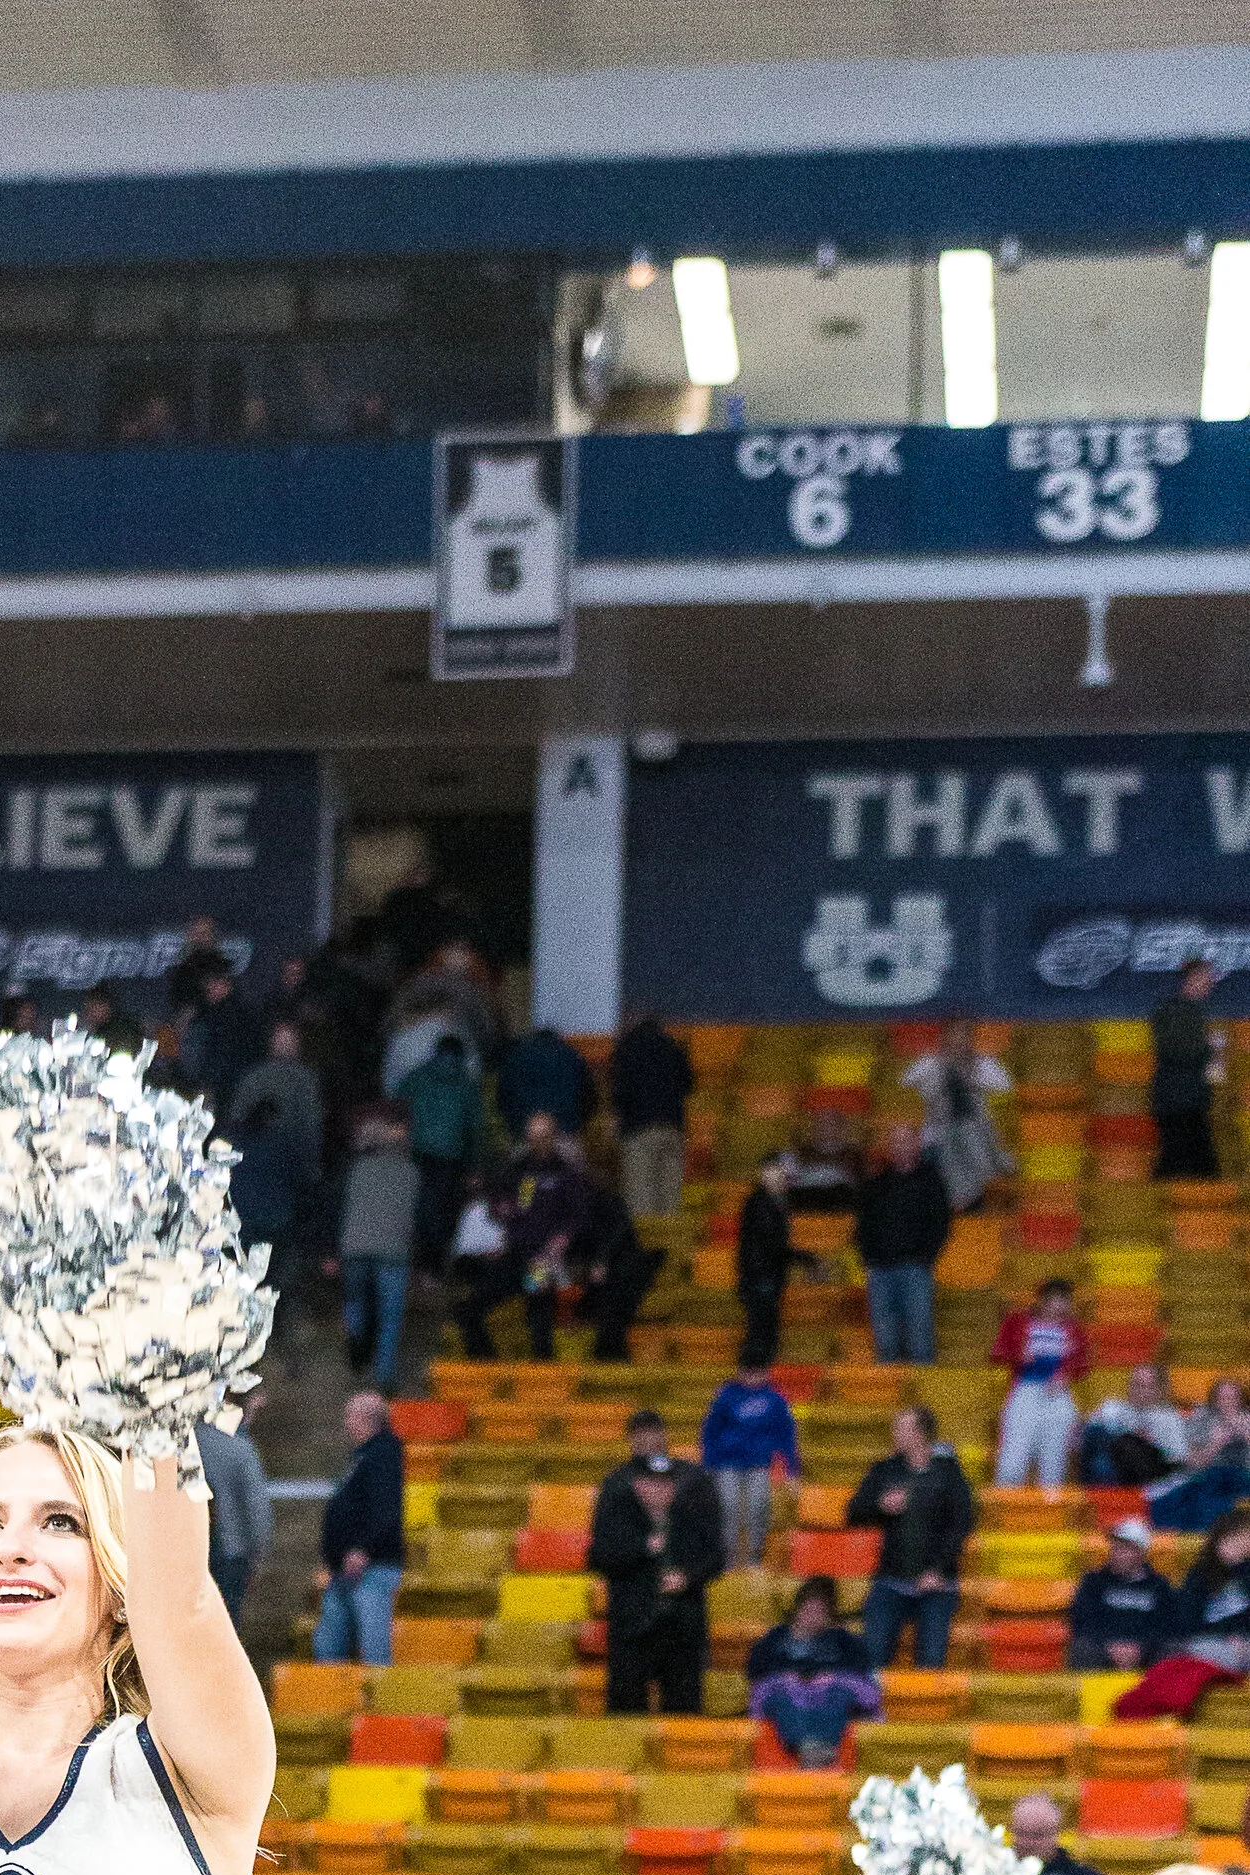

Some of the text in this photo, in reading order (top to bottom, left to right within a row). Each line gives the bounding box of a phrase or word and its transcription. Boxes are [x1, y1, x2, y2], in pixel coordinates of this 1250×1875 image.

[737, 431, 903, 479] COOK
[1007, 423, 1191, 472] ESTES
[789, 477, 851, 548] 6
[1035, 467, 1160, 543] 33
[807, 771, 1144, 858] THAT
